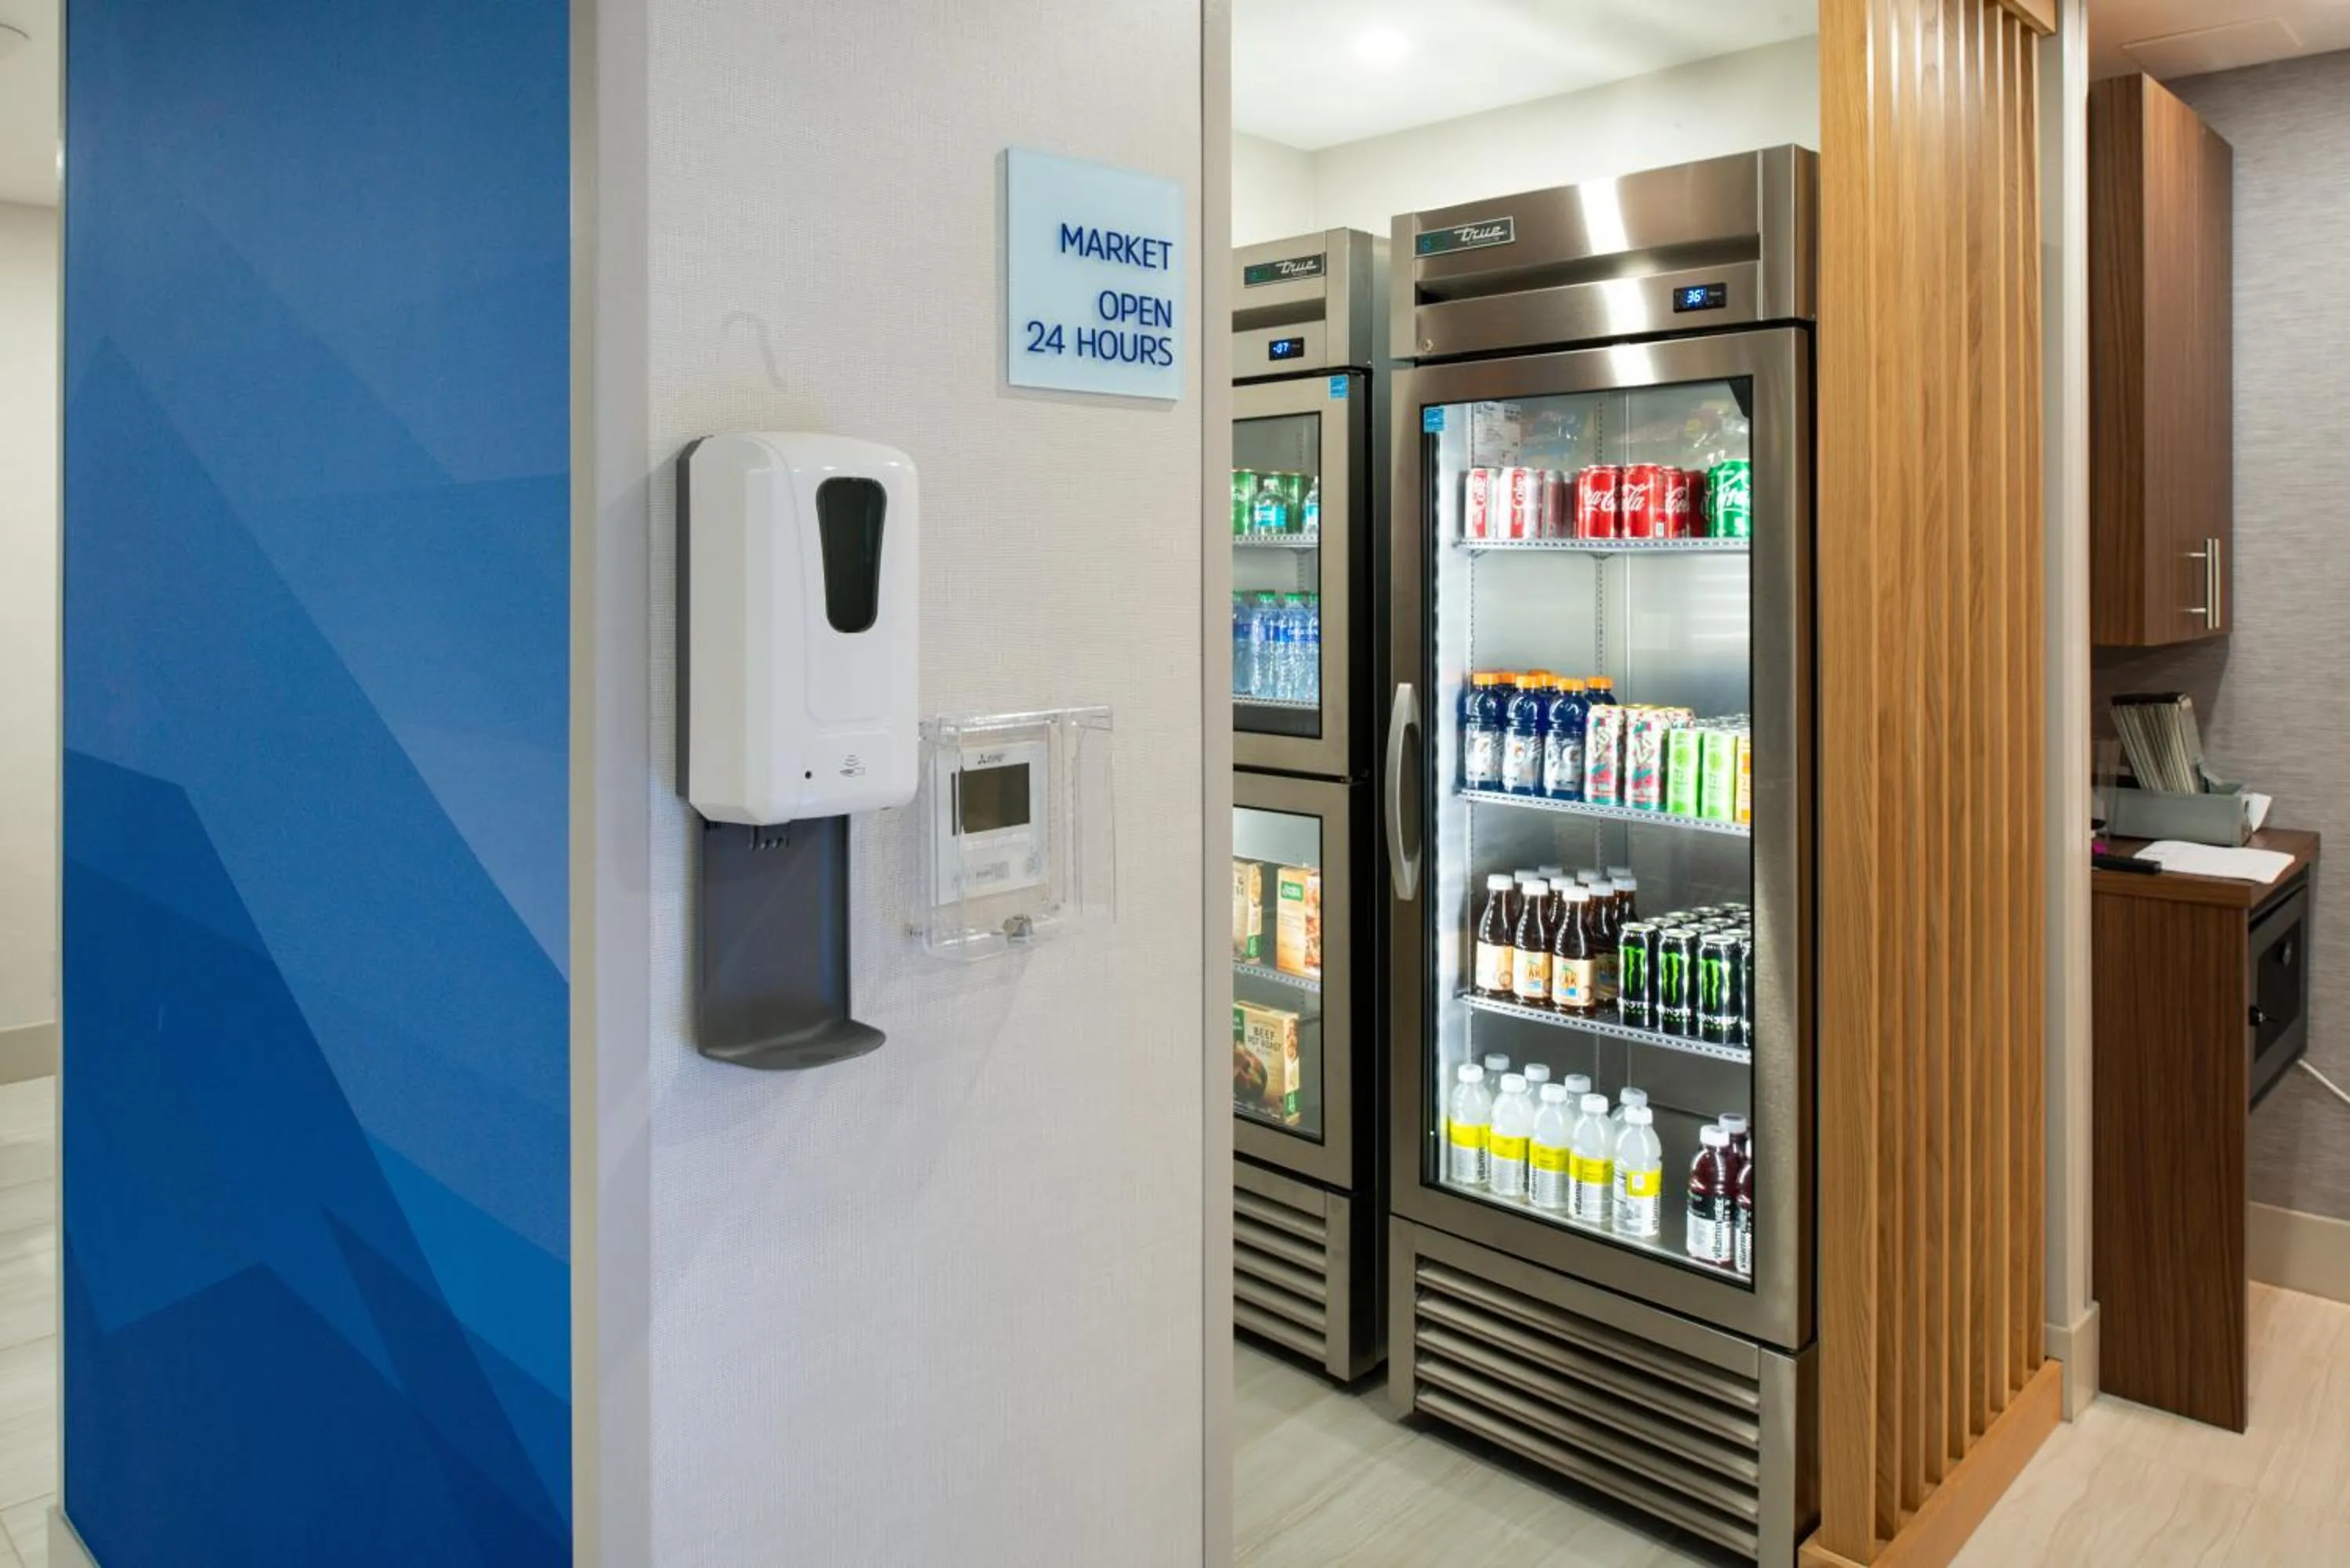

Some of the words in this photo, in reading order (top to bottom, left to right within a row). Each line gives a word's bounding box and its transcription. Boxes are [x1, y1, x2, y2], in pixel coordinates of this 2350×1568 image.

[1060, 222, 1173, 270] MARKET
[1098, 291, 1172, 328] OPEN
[1027, 321, 1065, 355] 24
[1077, 327, 1173, 366] HOURS
